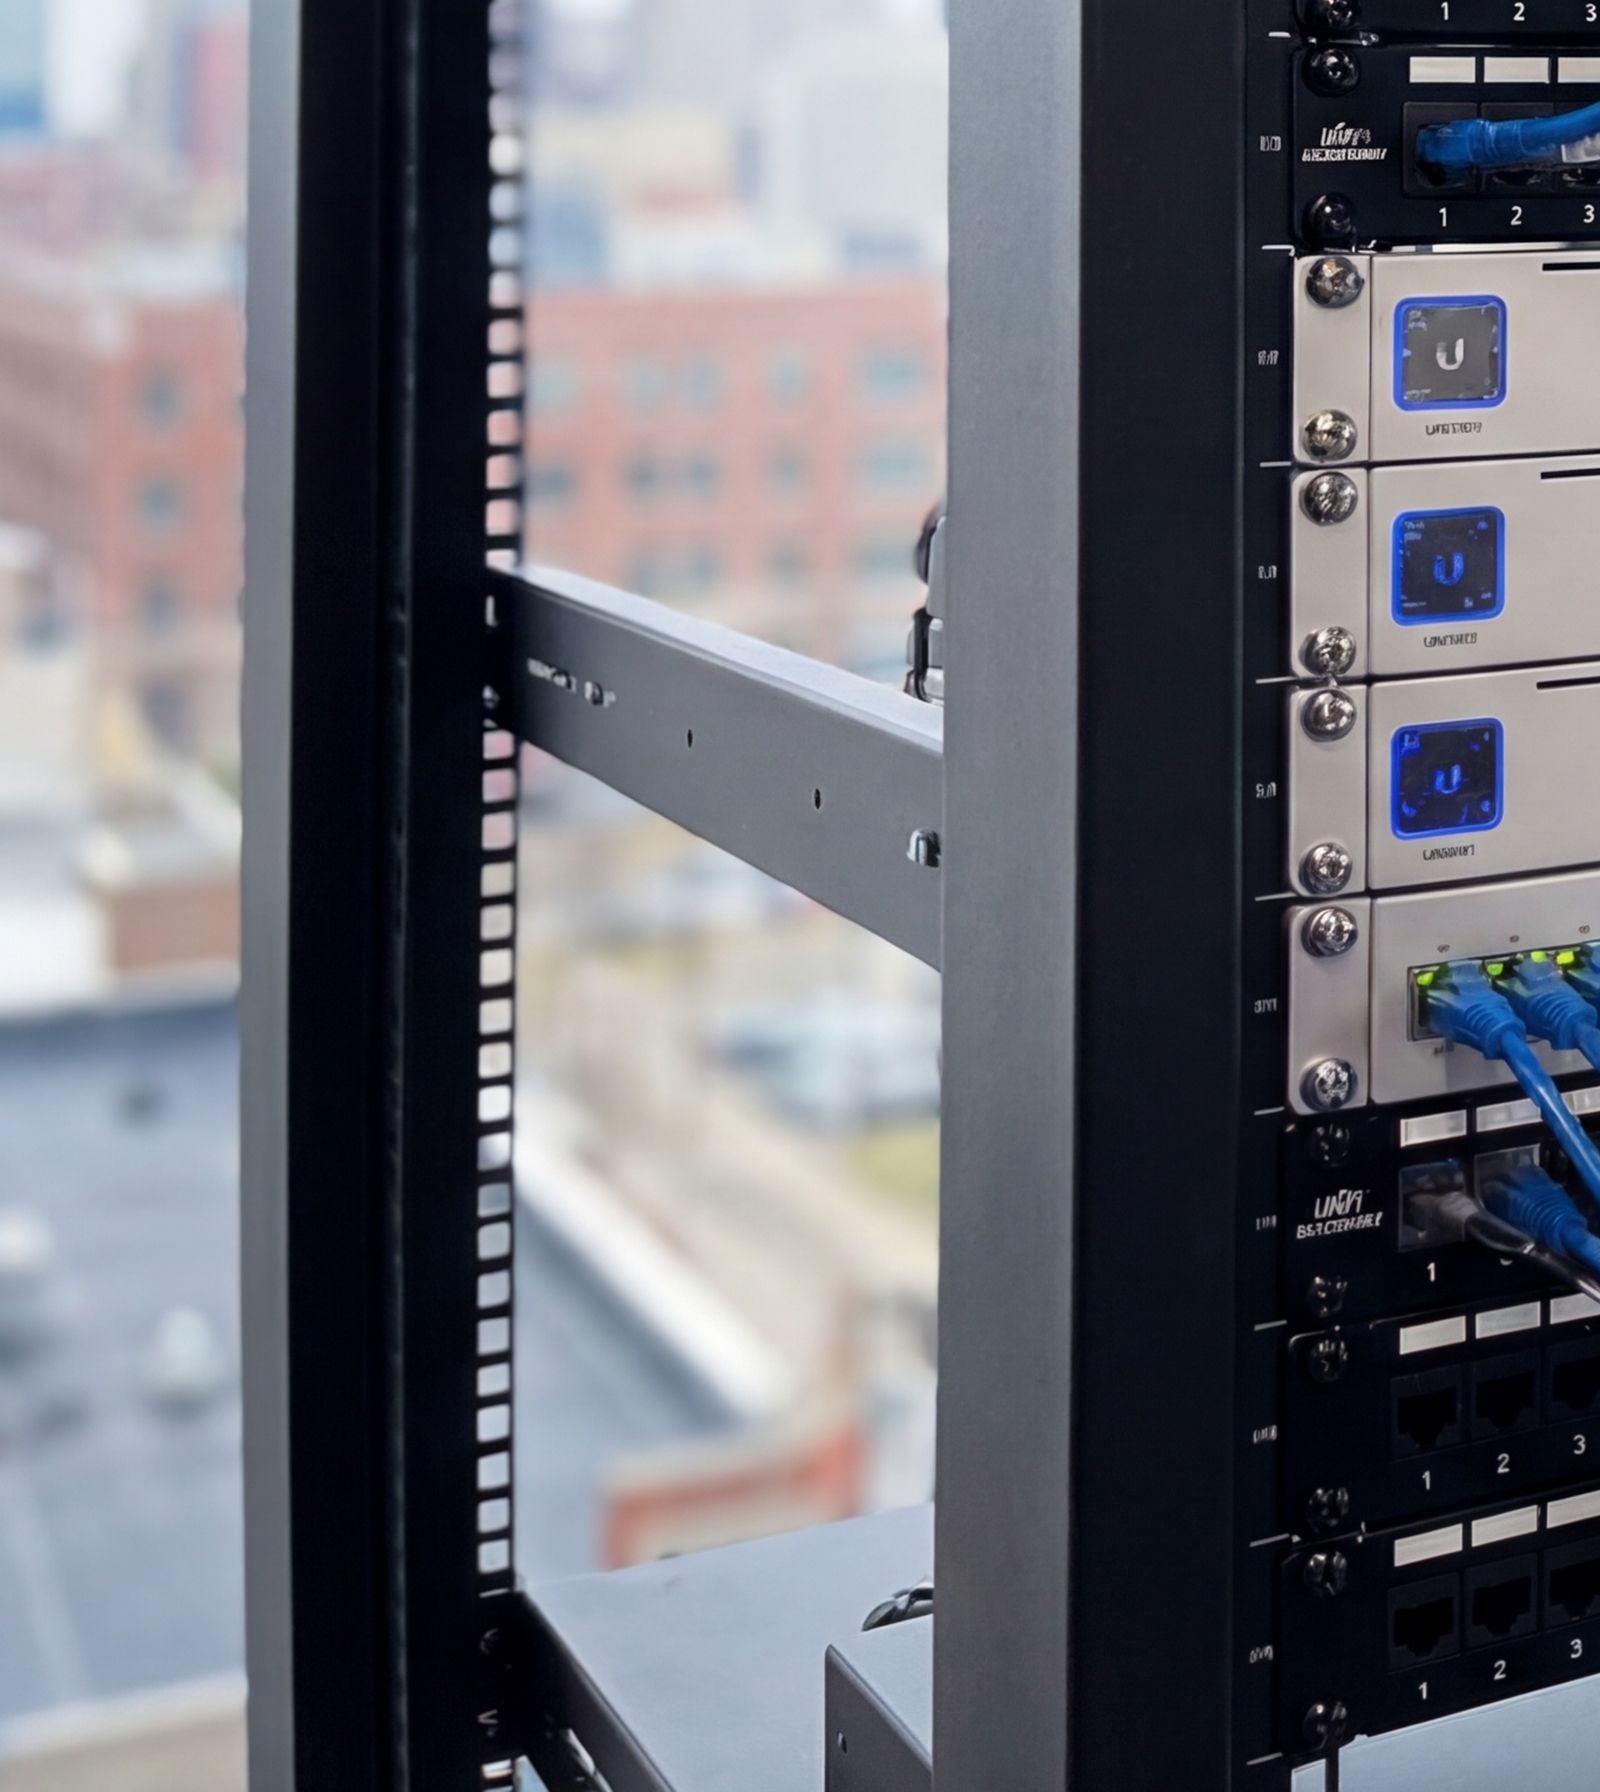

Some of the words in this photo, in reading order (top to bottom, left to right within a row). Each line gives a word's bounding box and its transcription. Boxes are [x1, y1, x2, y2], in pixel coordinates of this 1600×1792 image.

[1441, 1, 1449, 21] 1
[1513, 2, 1525, 21] 2
[1585, 3, 1597, 22] 3
[1439, 207, 1447, 227] 1
[1510, 205, 1523, 226] 2
[1583, 204, 1595, 224] 3
[1435, 338, 1465, 371] U
[1427, 1262, 1436, 1282] 1
[1421, 1470, 1431, 1490] 1
[1497, 1453, 1510, 1474] 2
[1573, 1434, 1586, 1455] 3
[1418, 1681, 1427, 1700] 1
[1493, 1659, 1506, 1681] 2
[1570, 1638, 1583, 1659] 3
